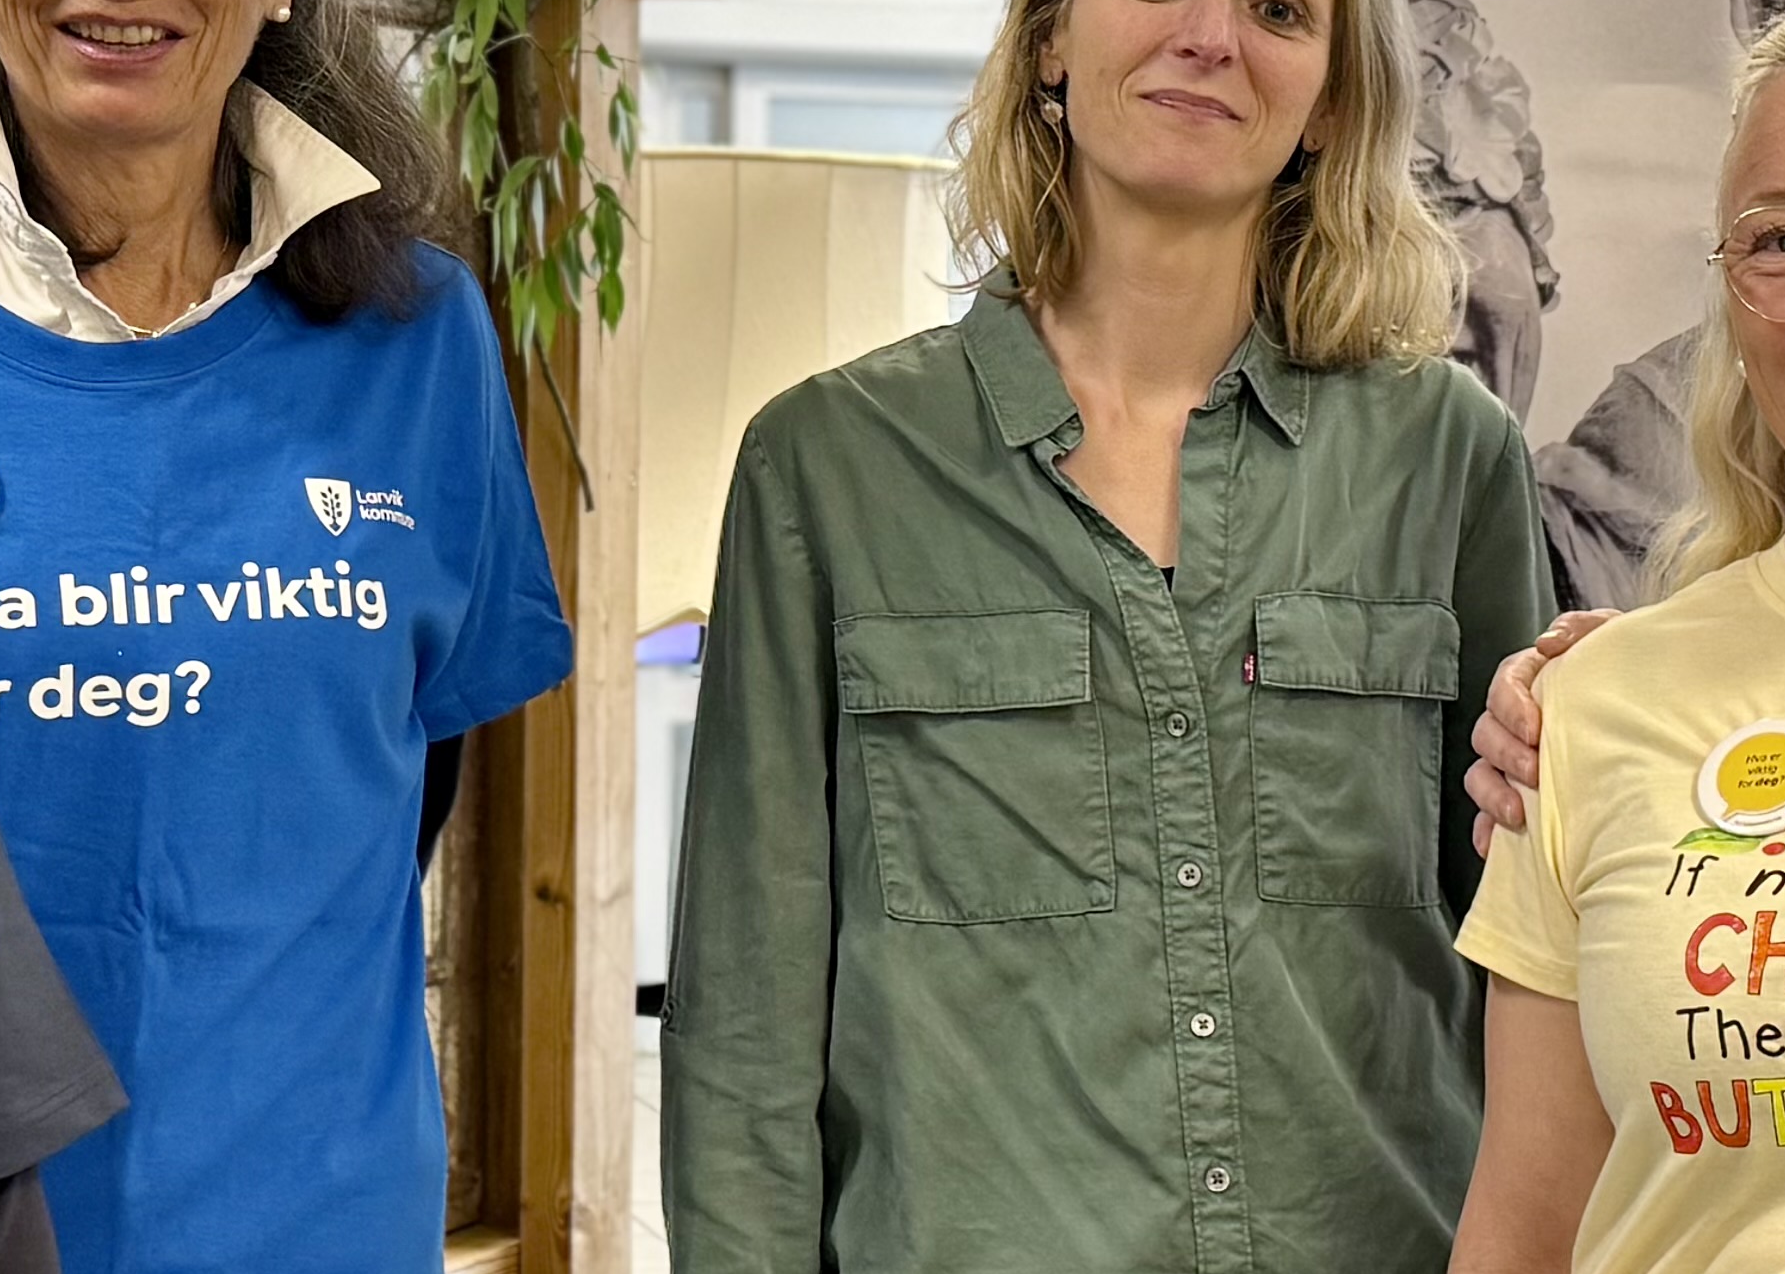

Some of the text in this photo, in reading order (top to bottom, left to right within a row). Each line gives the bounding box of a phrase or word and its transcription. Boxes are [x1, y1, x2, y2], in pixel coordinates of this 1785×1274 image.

[356, 489, 403, 507] Larvik
[58, 565, 186, 626] blir
[197, 559, 389, 631] viktig
[28, 659, 211, 727] deg?
[1665, 855, 1720, 897] If
